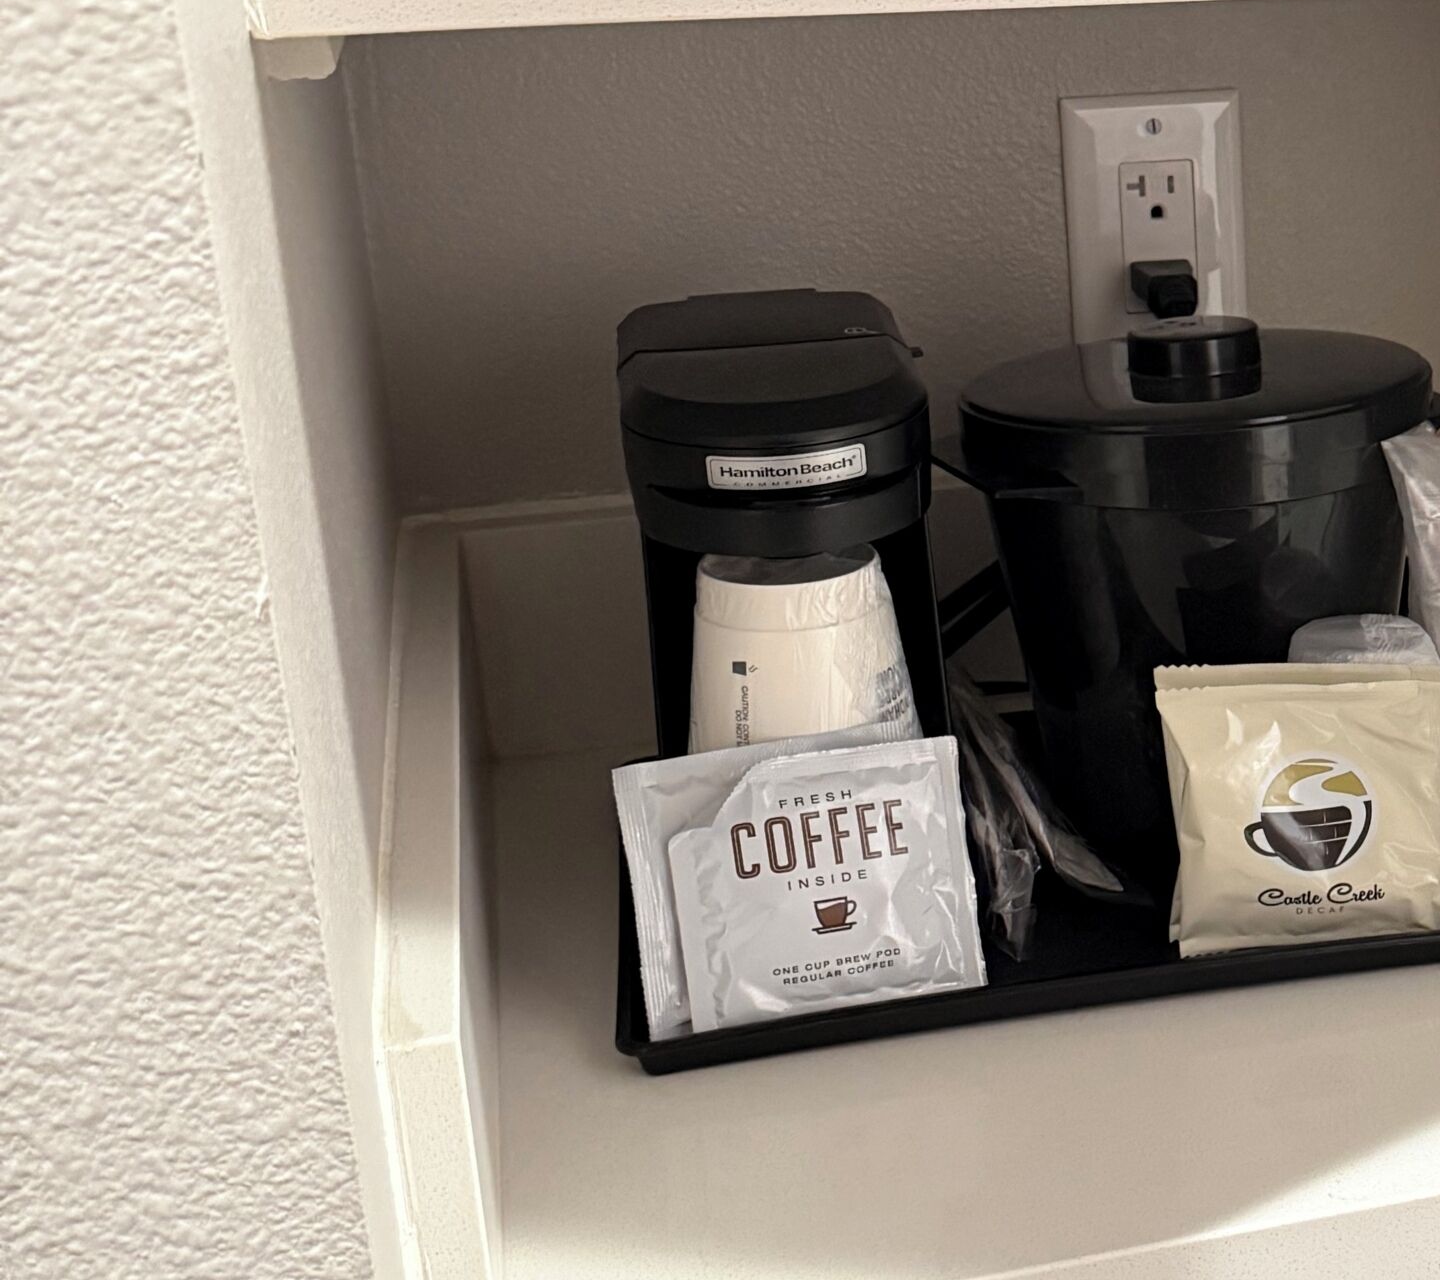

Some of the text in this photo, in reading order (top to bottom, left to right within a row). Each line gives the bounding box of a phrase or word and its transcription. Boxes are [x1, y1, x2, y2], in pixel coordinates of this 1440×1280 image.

[720, 465, 799, 478] Hamilton
[733, 474, 841, 487] COMMERCIAL
[779, 789, 852, 809] FRESH
[730, 799, 909, 880] COFFEE
[787, 869, 868, 891] INSIDE
[1257, 882, 1385, 907] Castle Creek
[1296, 906, 1345, 915] DECAF
[772, 948, 901, 976] ONE CUP BREW POD
[783, 959, 895, 985] REGULAR COFFEE
